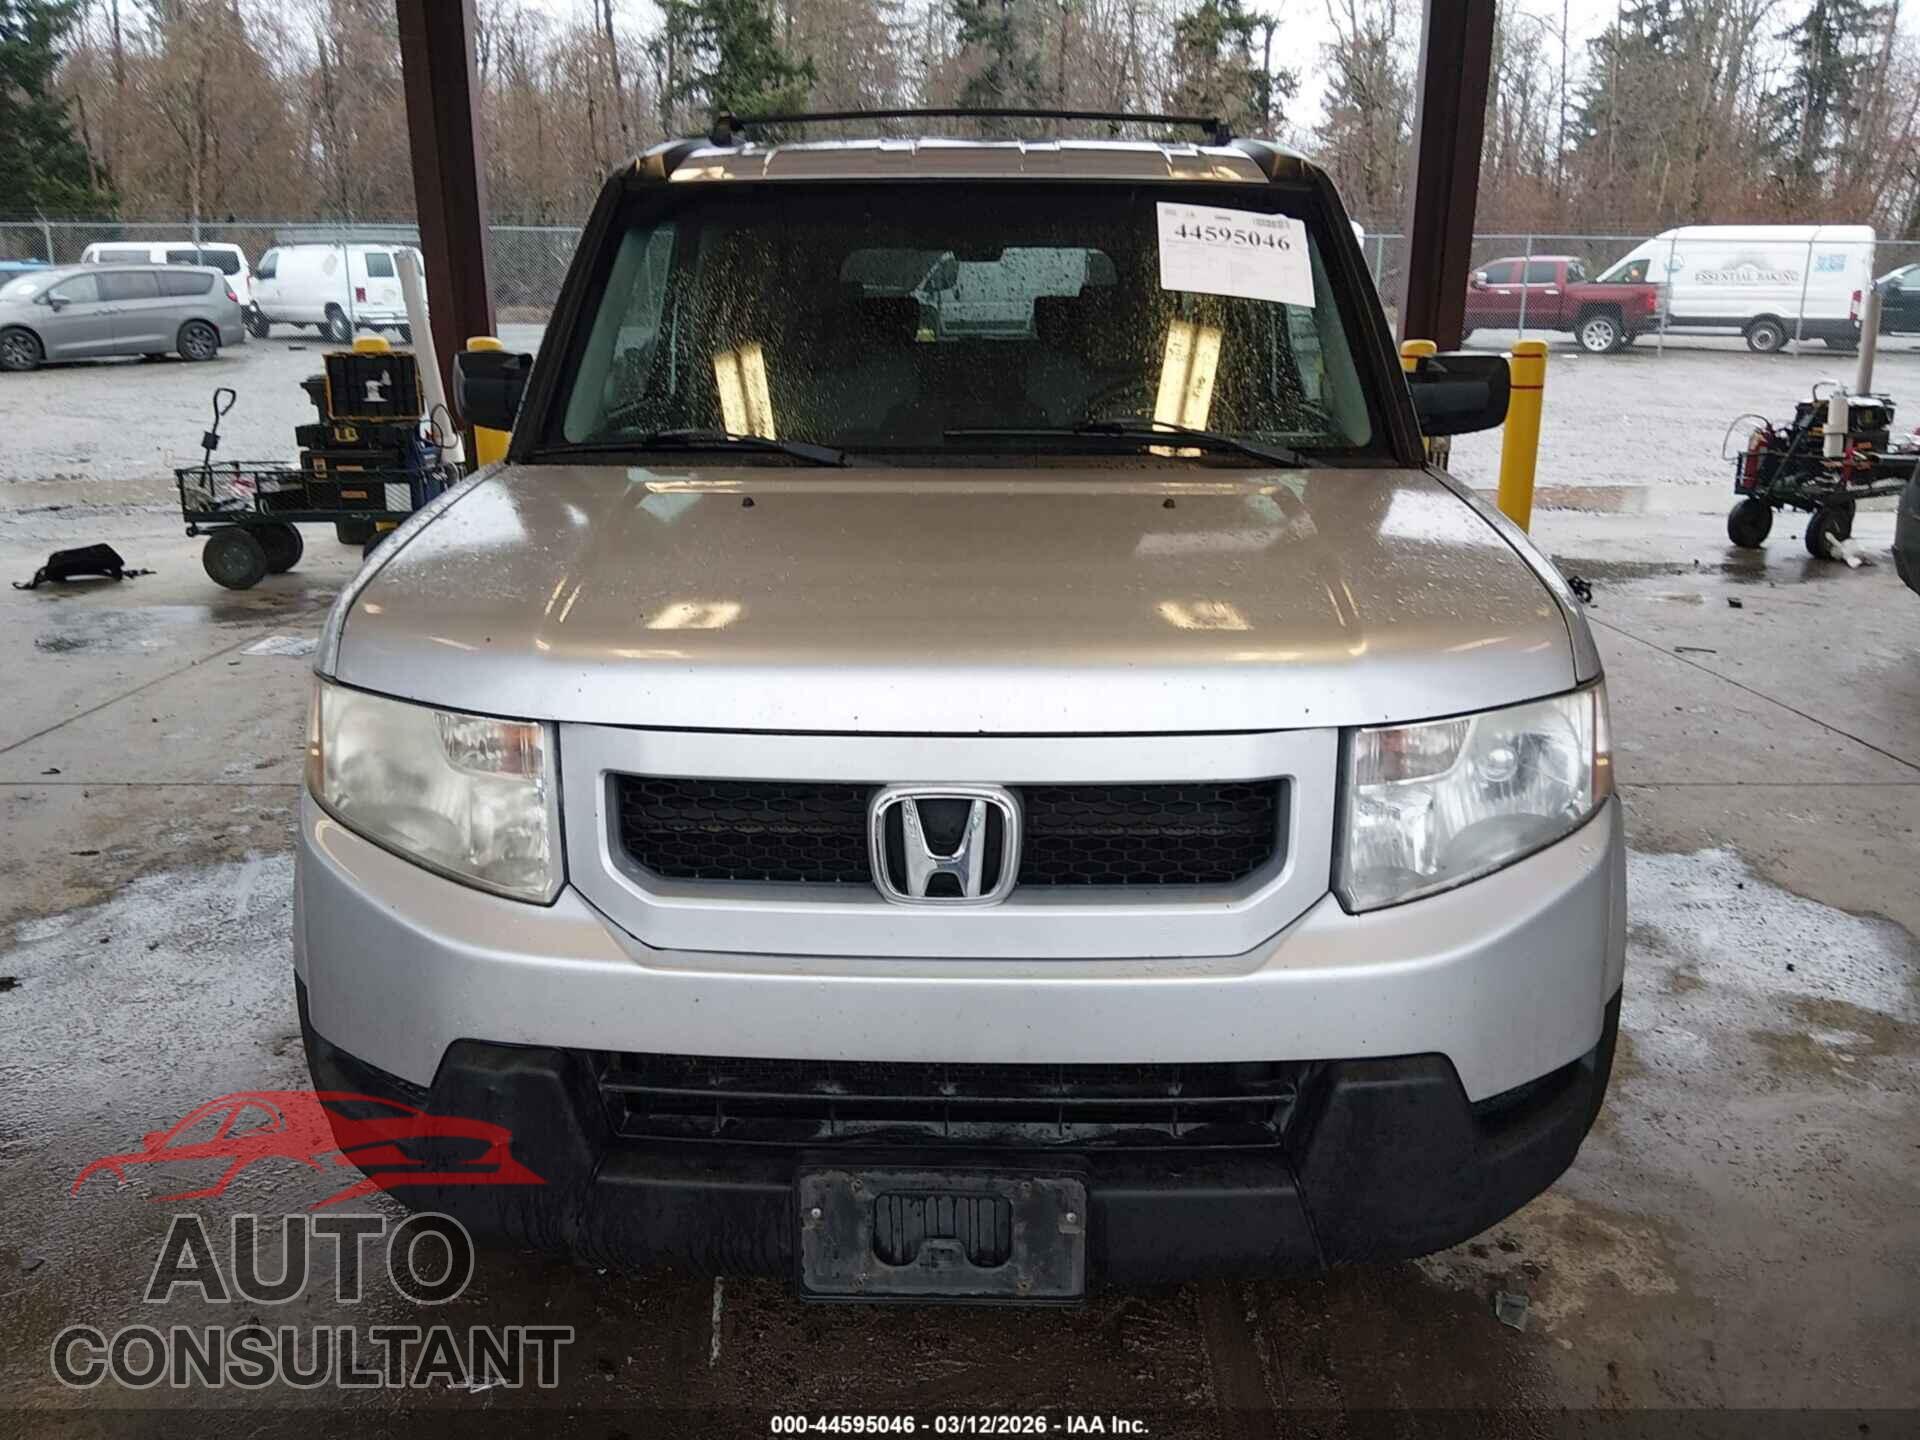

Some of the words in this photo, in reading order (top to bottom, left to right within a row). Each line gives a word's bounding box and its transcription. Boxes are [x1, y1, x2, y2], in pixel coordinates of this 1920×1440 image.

[1174, 223, 1290, 250] 44595046
[1695, 270, 1752, 282] ESSENTIAL
[1755, 269, 1800, 282] BAKING
